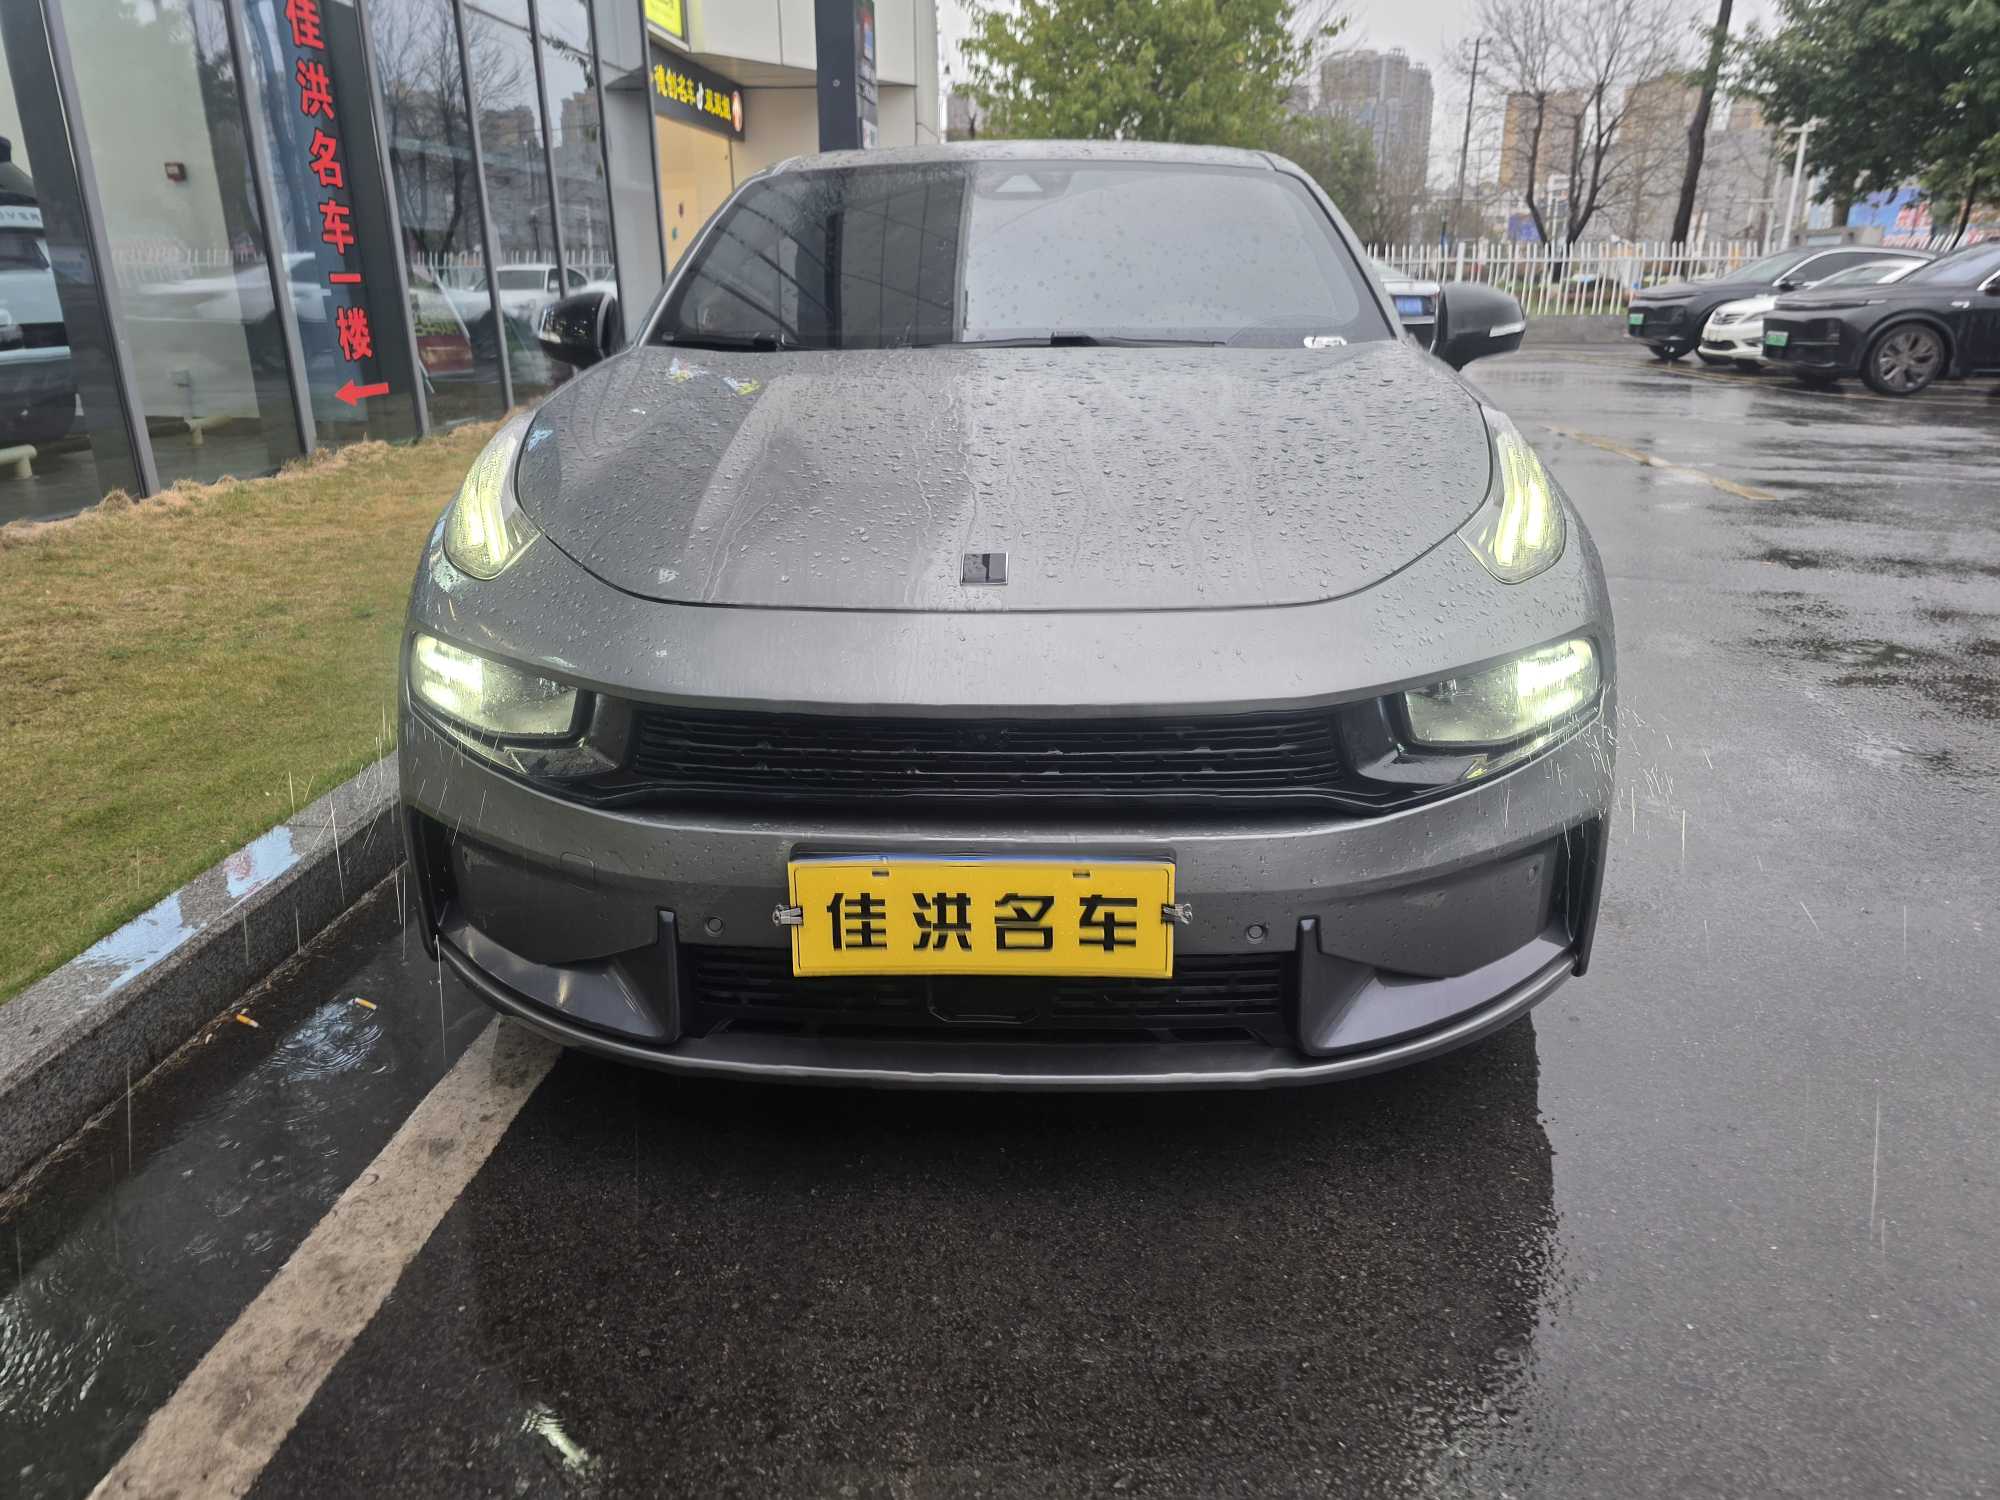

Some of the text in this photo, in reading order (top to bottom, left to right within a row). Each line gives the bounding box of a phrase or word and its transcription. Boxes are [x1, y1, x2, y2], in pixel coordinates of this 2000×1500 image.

[284, 0, 373, 361] 佳洪名车一楼
[826, 892, 1138, 953] 佳洪名车
